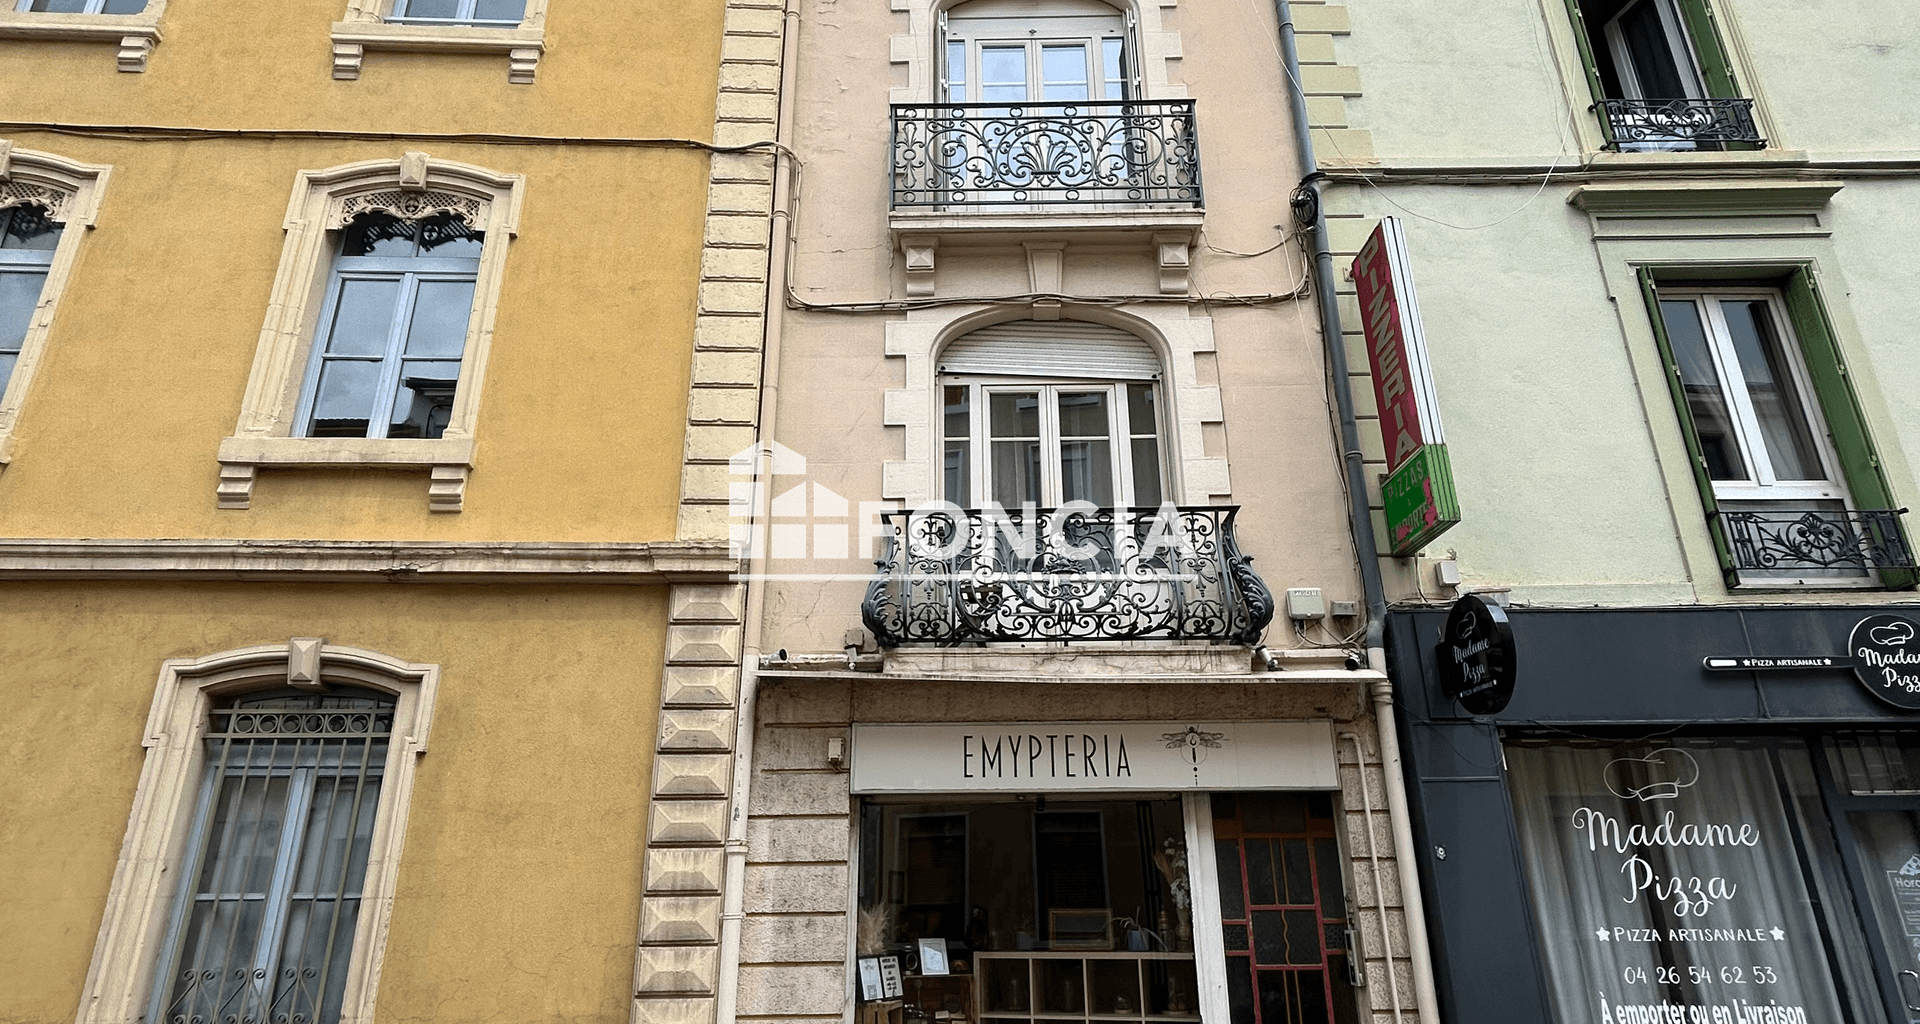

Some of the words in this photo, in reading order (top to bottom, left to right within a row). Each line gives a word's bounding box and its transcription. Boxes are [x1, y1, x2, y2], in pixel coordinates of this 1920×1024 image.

[1359, 234, 1417, 467] PIZZERIA
[1387, 459, 1424, 504] PIZZAS
[1453, 638, 1489, 664] Madame
[1858, 647, 1920, 667] Mada
[1463, 662, 1486, 684] Pizza
[964, 733, 1132, 778] EMYPTERIA
[1572, 807, 1759, 854] Madame
[1621, 854, 1737, 917] Pizza
[1614, 926, 1661, 942] PIZZA
[1669, 928, 1767, 942] ARTISANALE
[1624, 966, 1647, 984] 04
[1656, 966, 1681, 984] 26
[1688, 966, 1711, 984] 54
[1721, 966, 1747, 984] 62
[1753, 966, 1777, 984] 53
[1599, 991, 1612, 1024] À
[1616, 999, 1686, 1024] emporter
[1690, 1003, 1709, 1024] ou
[1712, 1003, 1731, 1024] en
[1733, 999, 1807, 1024] Livraison
